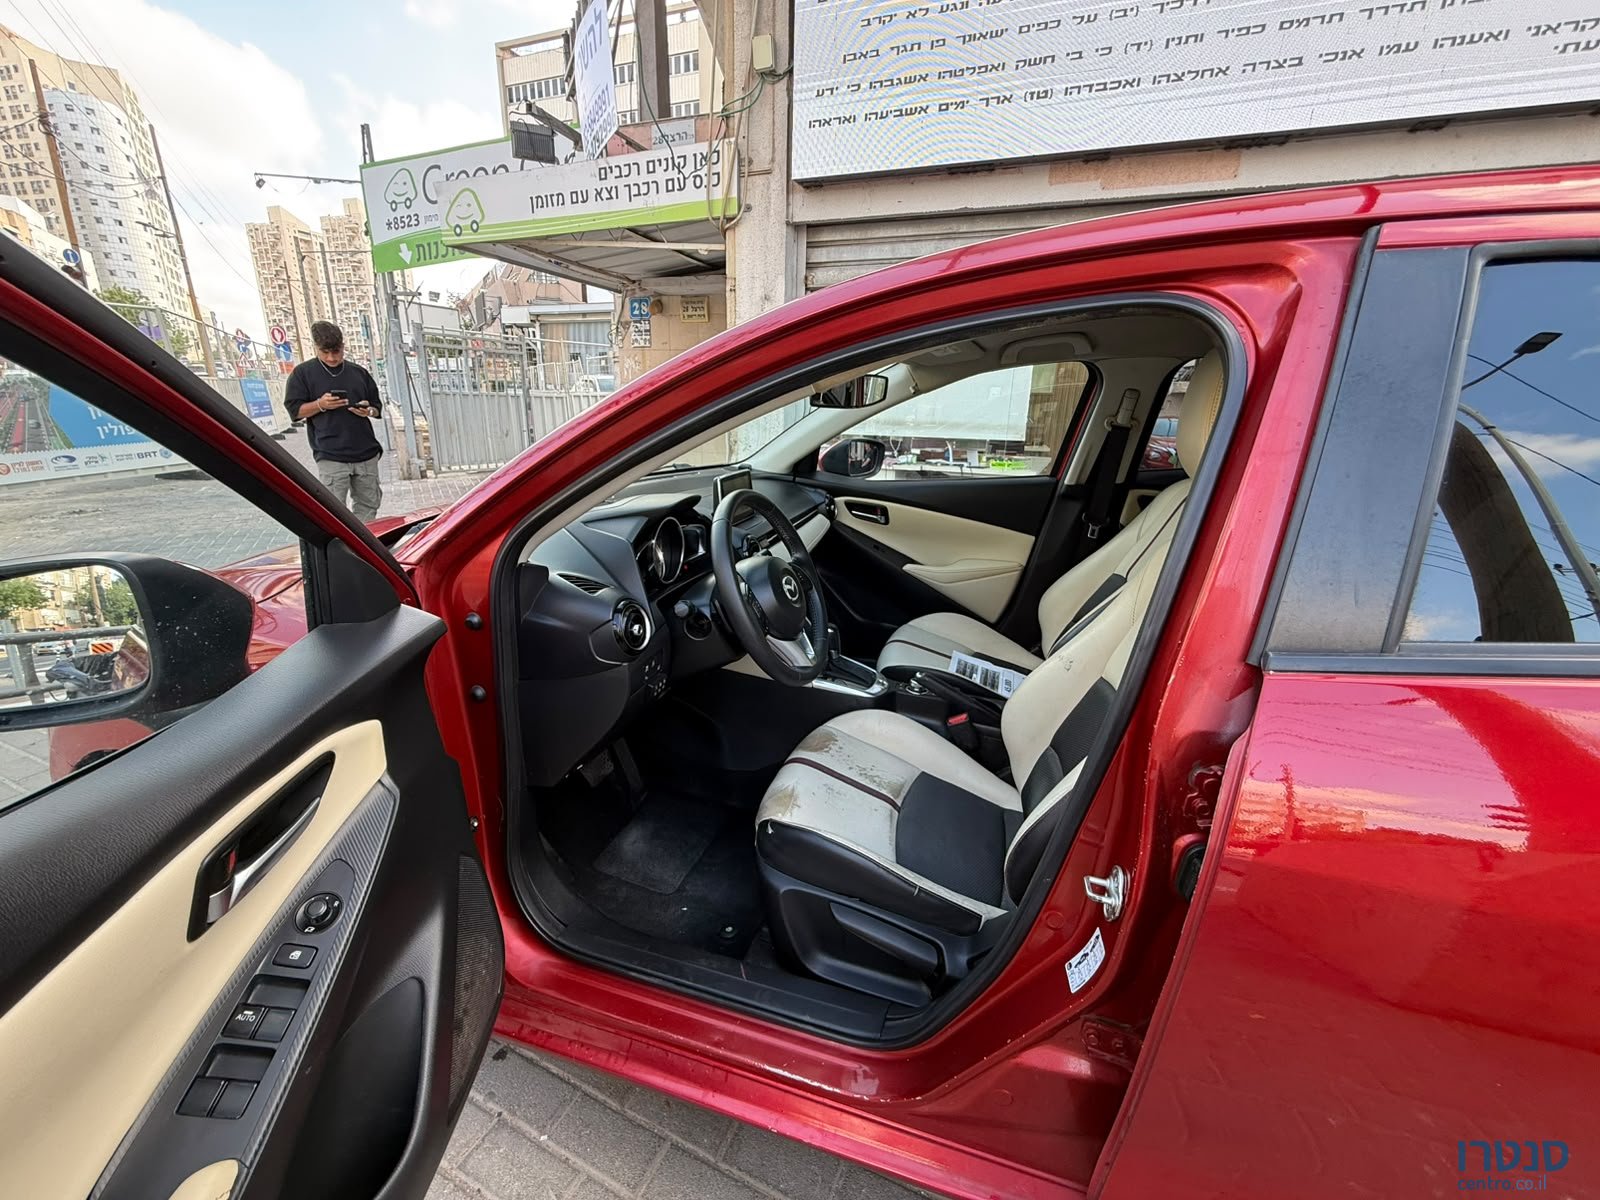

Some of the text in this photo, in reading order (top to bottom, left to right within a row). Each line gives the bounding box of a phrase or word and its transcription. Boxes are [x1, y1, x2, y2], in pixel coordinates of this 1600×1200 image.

[906, 7, 930, 20] לא
[1359, 1, 1427, 20] תדרך
[861, 13, 898, 28] יקרב
[1018, 19, 1061, 34] כפים
[1072, 13, 1098, 25] על
[1278, 12, 1344, 30] תרמס
[956, 28, 1009, 45] ישאונך
[1217, 23, 1267, 38] כפיר
[931, 38, 946, 50] פן
[1164, 33, 1204, 50] ותנין
[1432, 29, 1511, 49] ואענהו
[890, 42, 921, 56] תגף
[1066, 50, 1084, 61] בי
[1095, 46, 1113, 57] כי
[1318, 48, 1366, 63] אנכי
[1378, 41, 1420, 56] עמו
[843, 49, 881, 64] באבן
[1015, 54, 1056, 70] חשק
[1241, 55, 1304, 73] בצרה
[937, 62, 1006, 80] ואפלטהו
[1151, 65, 1230, 86] אחלצהו
[847, 83, 861, 93] כי
[869, 73, 929, 90] אשגבהו
[1064, 77, 1142, 96] ואכבדהו
[815, 86, 838, 98] ידע
[938, 100, 970, 112] ימים
[979, 93, 1013, 107] ארך
[864, 105, 929, 122] אשביעהו
[808, 114, 857, 129] ואראהו
[598, 149, 721, 182] כאן קונים רכבים
[624, 180, 660, 203] רכבך
[665, 176, 686, 192] עם
[570, 189, 589, 206] עם
[594, 185, 619, 202] וצא
[529, 192, 565, 214] מזומן
[632, 302, 648, 315] 28
[235, 1013, 256, 1022] AUTO
